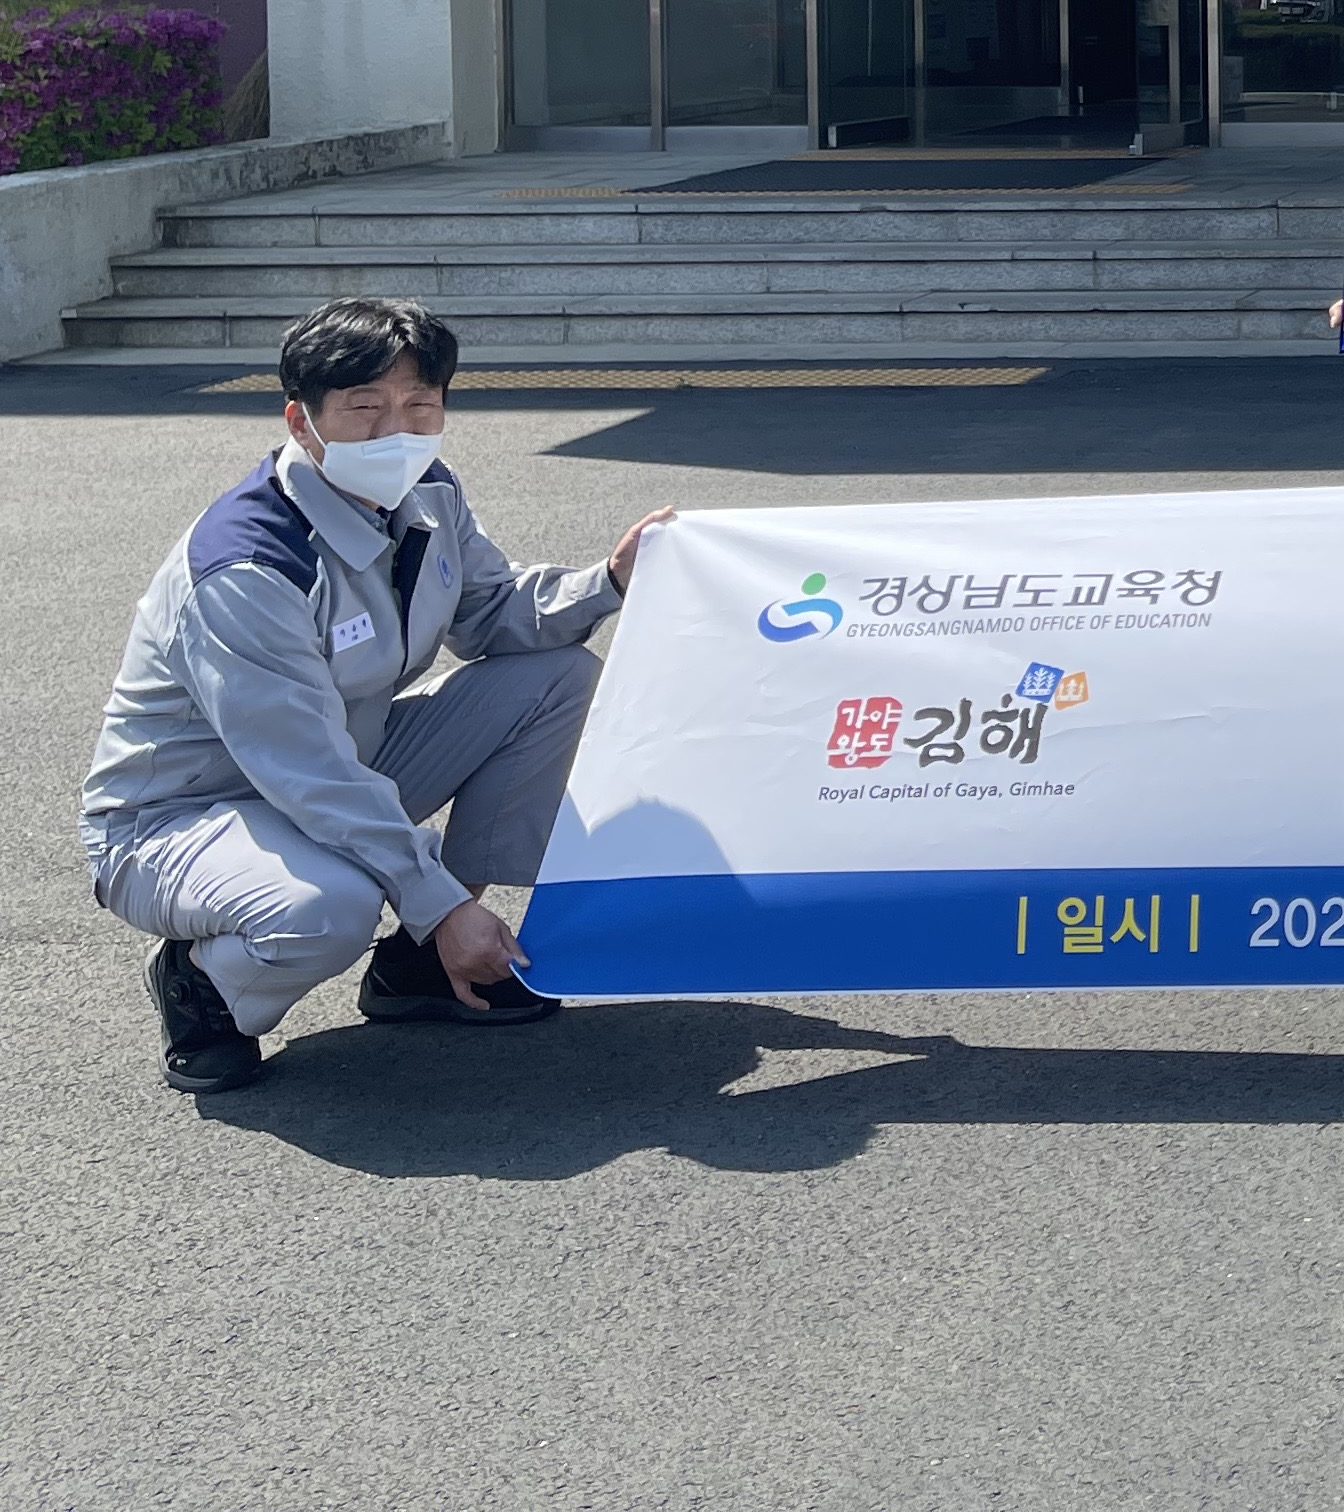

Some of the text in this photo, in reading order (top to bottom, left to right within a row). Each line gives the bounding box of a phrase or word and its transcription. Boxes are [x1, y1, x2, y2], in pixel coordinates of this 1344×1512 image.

[858, 569, 1222, 617] 경상남도교육청
[846, 613, 1212, 638] GYEONGSANGNAMDO OFFICE OF EDUCATION
[842, 698, 902, 730] 가야
[903, 693, 1048, 768] 김해
[829, 733, 893, 766] 왕도
[818, 781, 1075, 803] Royal Capital of Gaya, Gimhae
